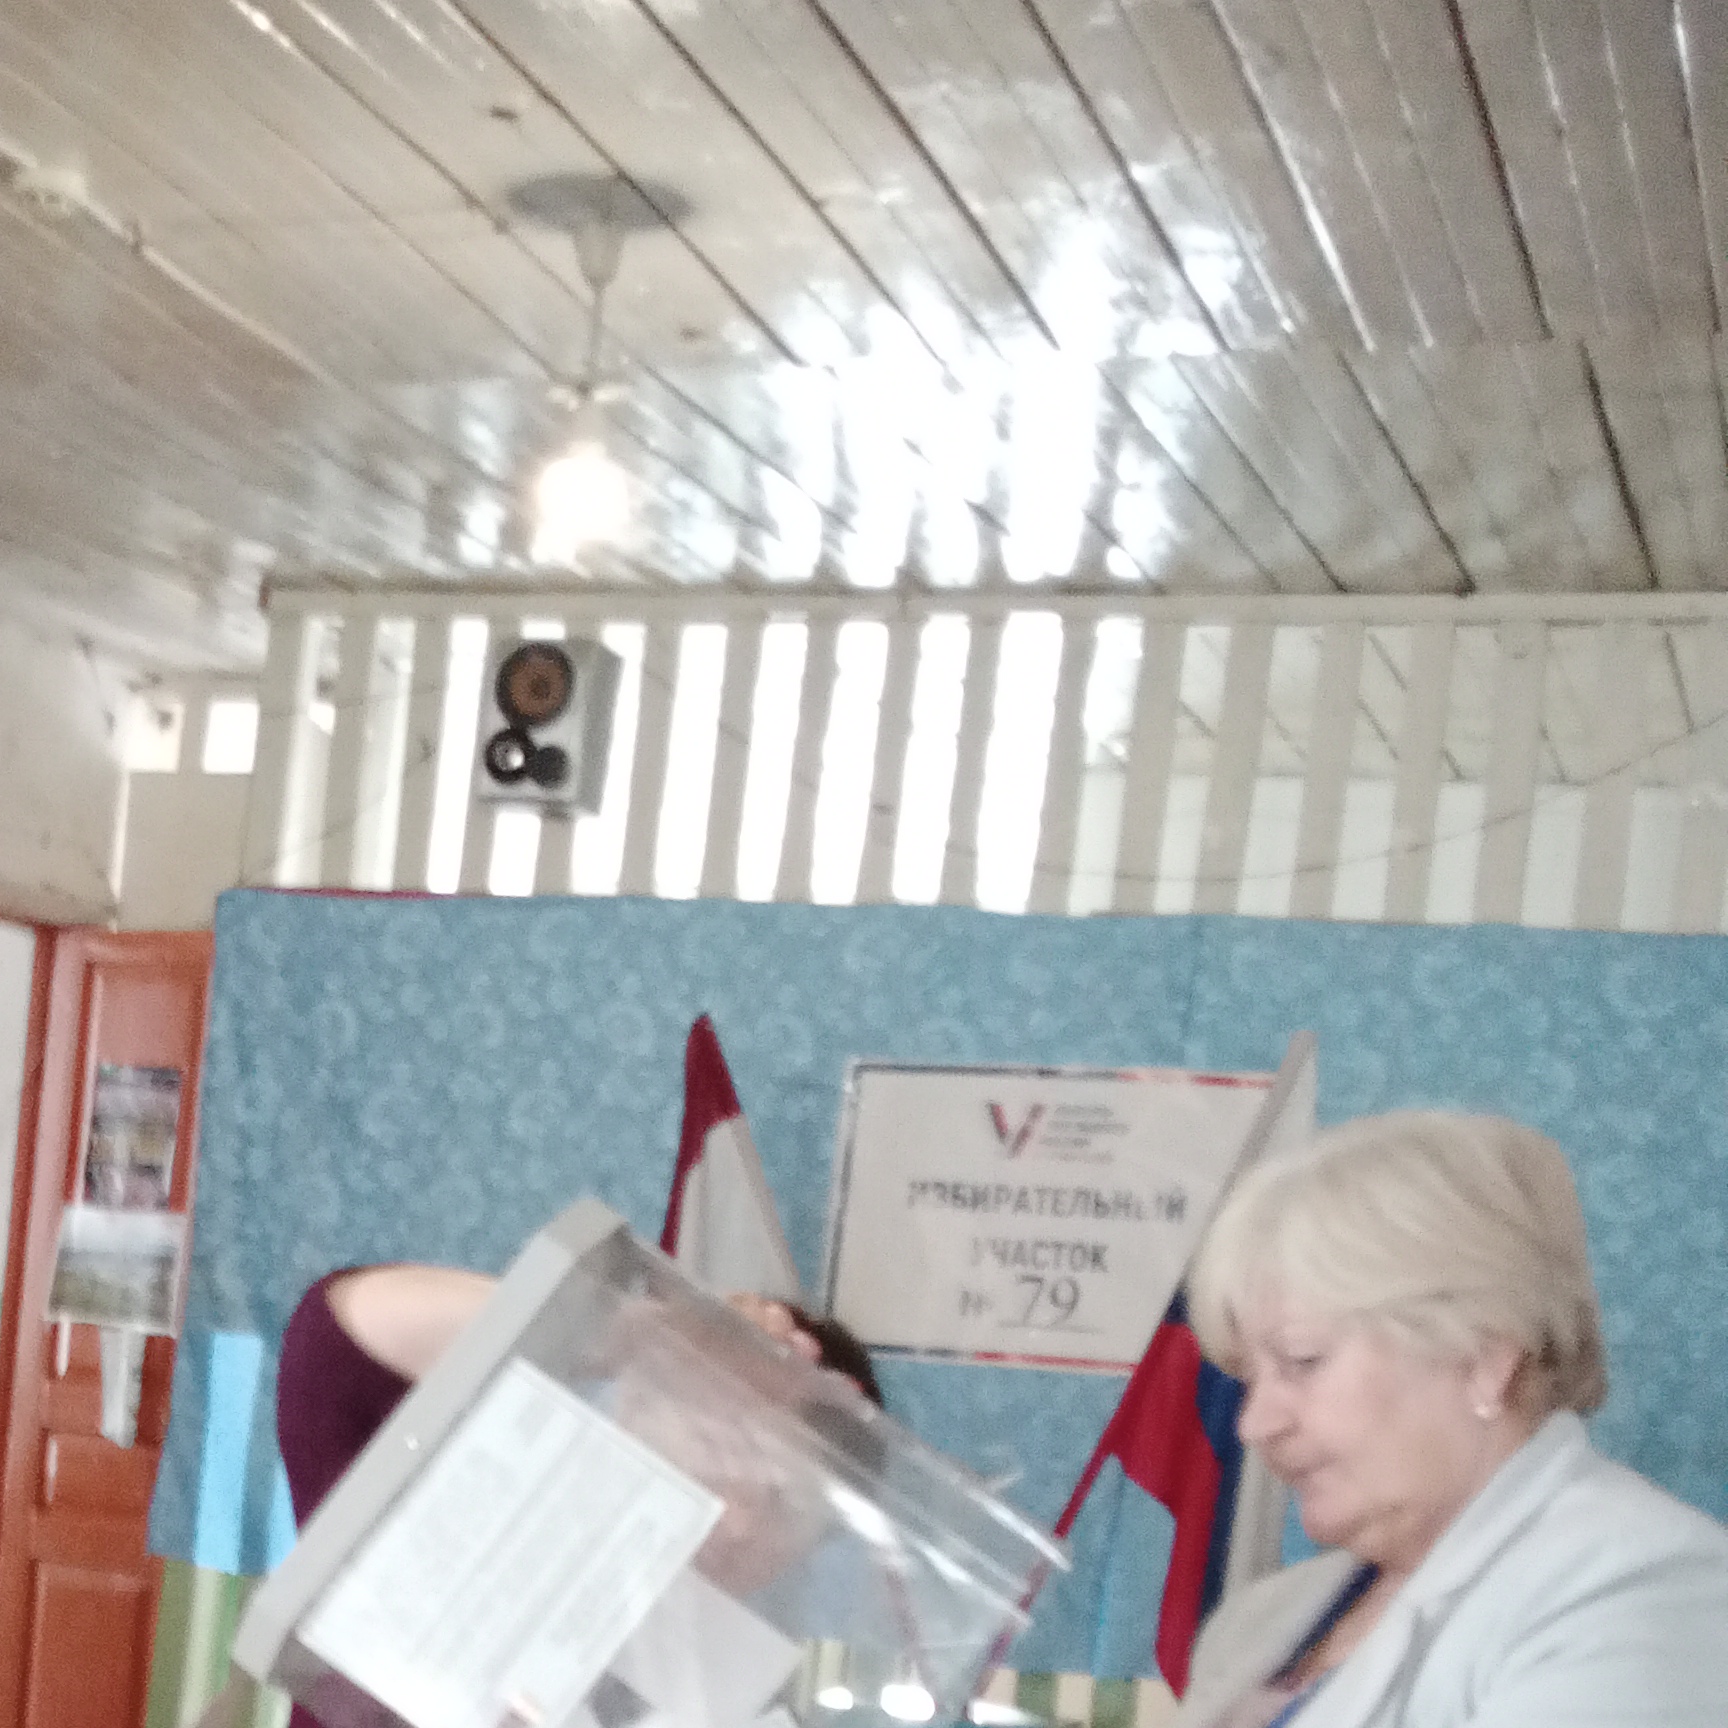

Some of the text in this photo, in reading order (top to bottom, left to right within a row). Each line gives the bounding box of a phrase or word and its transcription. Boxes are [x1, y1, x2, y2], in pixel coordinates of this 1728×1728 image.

[908, 1178, 1189, 1223] ИЗБИРАТЕЛЬНЫЙ
[973, 1237, 1110, 1274] УЧАСТОК
[1016, 1274, 1082, 1326] 79
